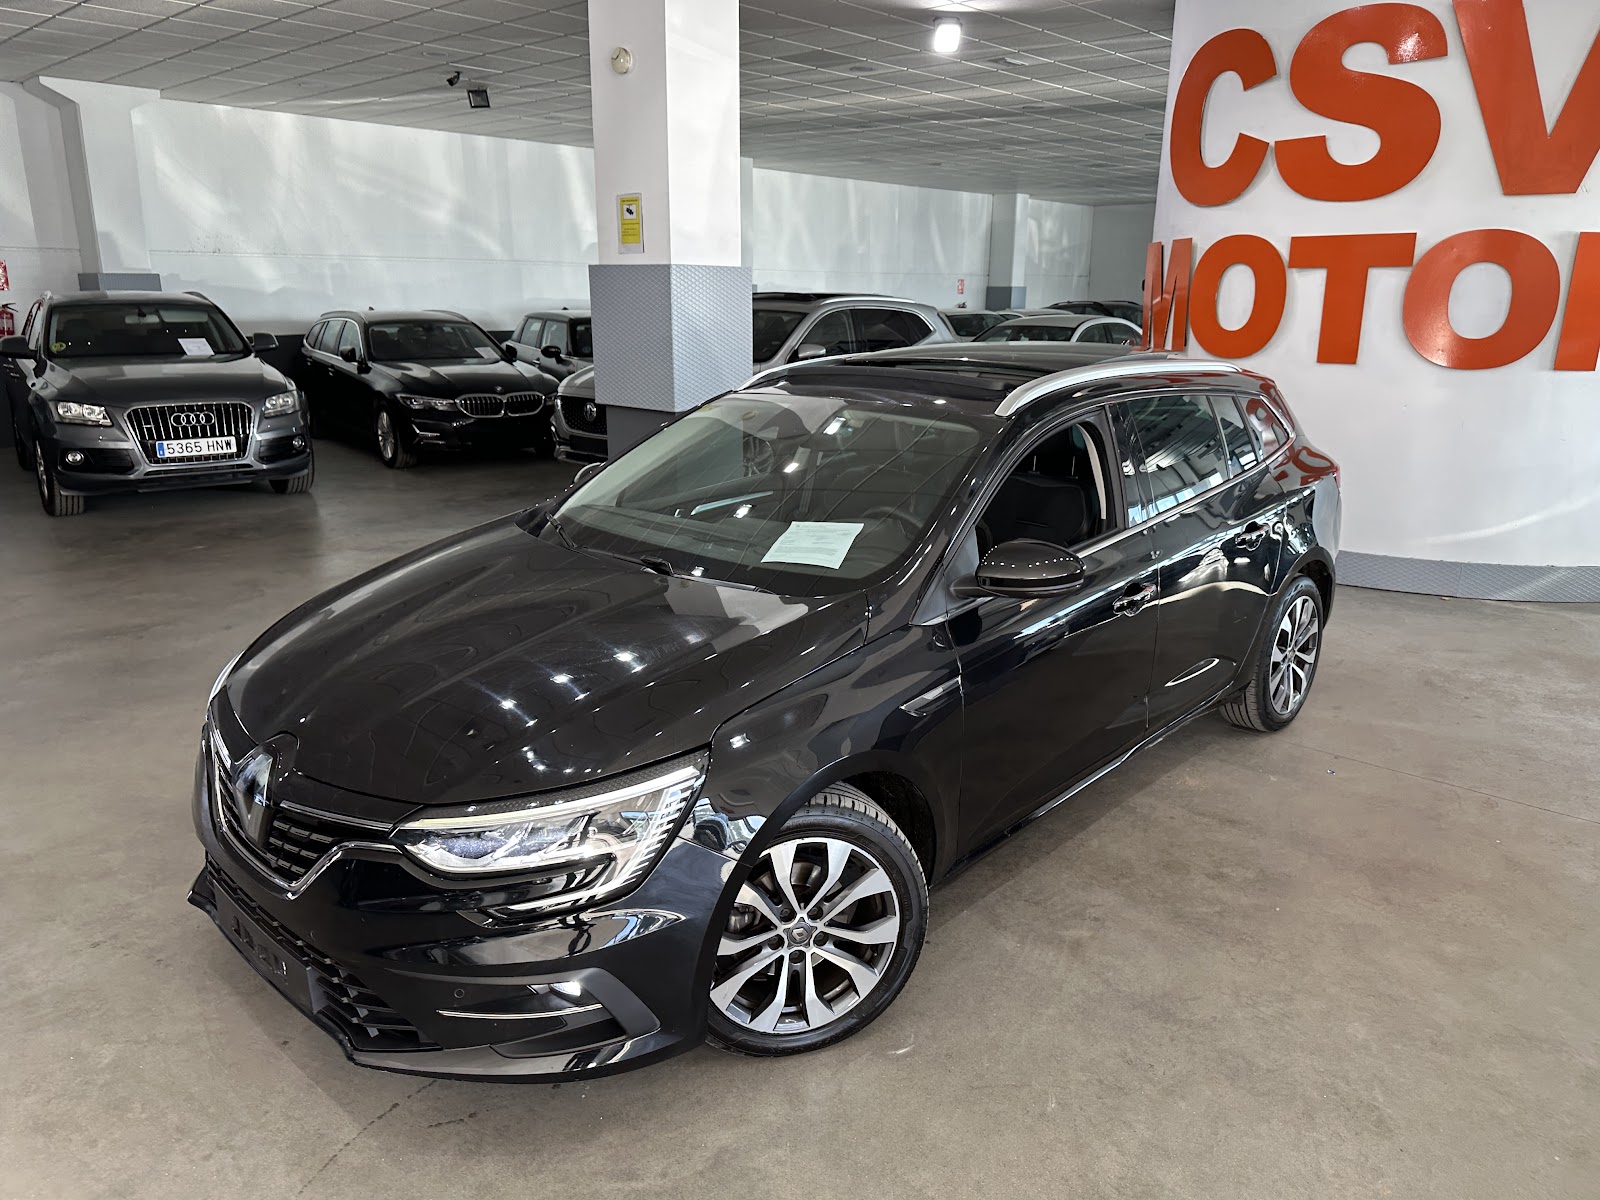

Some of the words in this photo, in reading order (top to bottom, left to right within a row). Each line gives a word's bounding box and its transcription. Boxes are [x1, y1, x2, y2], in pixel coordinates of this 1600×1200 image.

[1170, 0, 1600, 206] CSV
[166, 441, 202, 455] 5365
[206, 439, 232, 452] HNW
